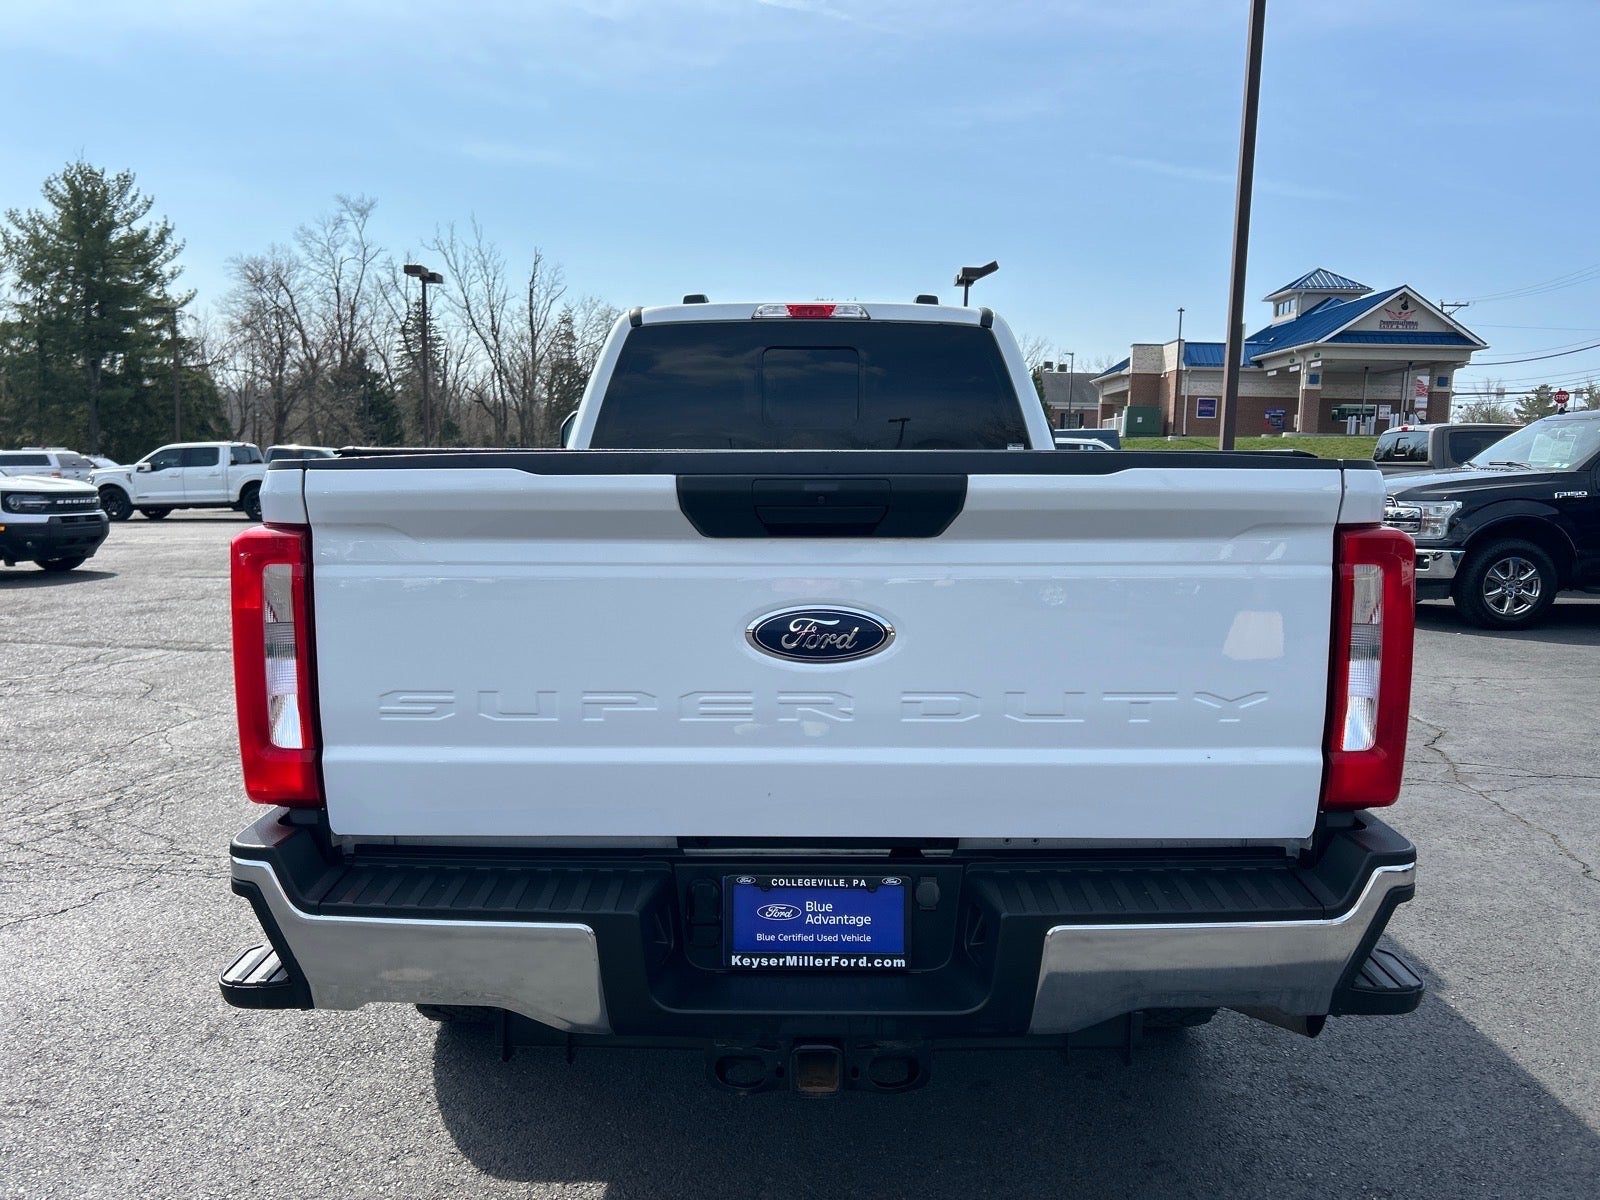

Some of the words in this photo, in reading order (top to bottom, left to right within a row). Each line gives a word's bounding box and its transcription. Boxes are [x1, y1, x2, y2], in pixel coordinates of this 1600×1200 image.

[781, 617, 860, 650] Ford
[379, 690, 855, 722] SUPER
[900, 690, 1269, 723] DUTY
[771, 878, 848, 888] COLLEGEVILLE,
[852, 879, 867, 888] PA
[765, 905, 793, 919] Ford
[805, 901, 833, 912] Blue
[805, 913, 872, 927] Advantage
[756, 933, 776, 942] Blue
[777, 933, 814, 942] Certified
[816, 934, 838, 942] Used
[841, 934, 872, 942] Vehicle
[731, 955, 906, 969] KeyserMillerFord.com
